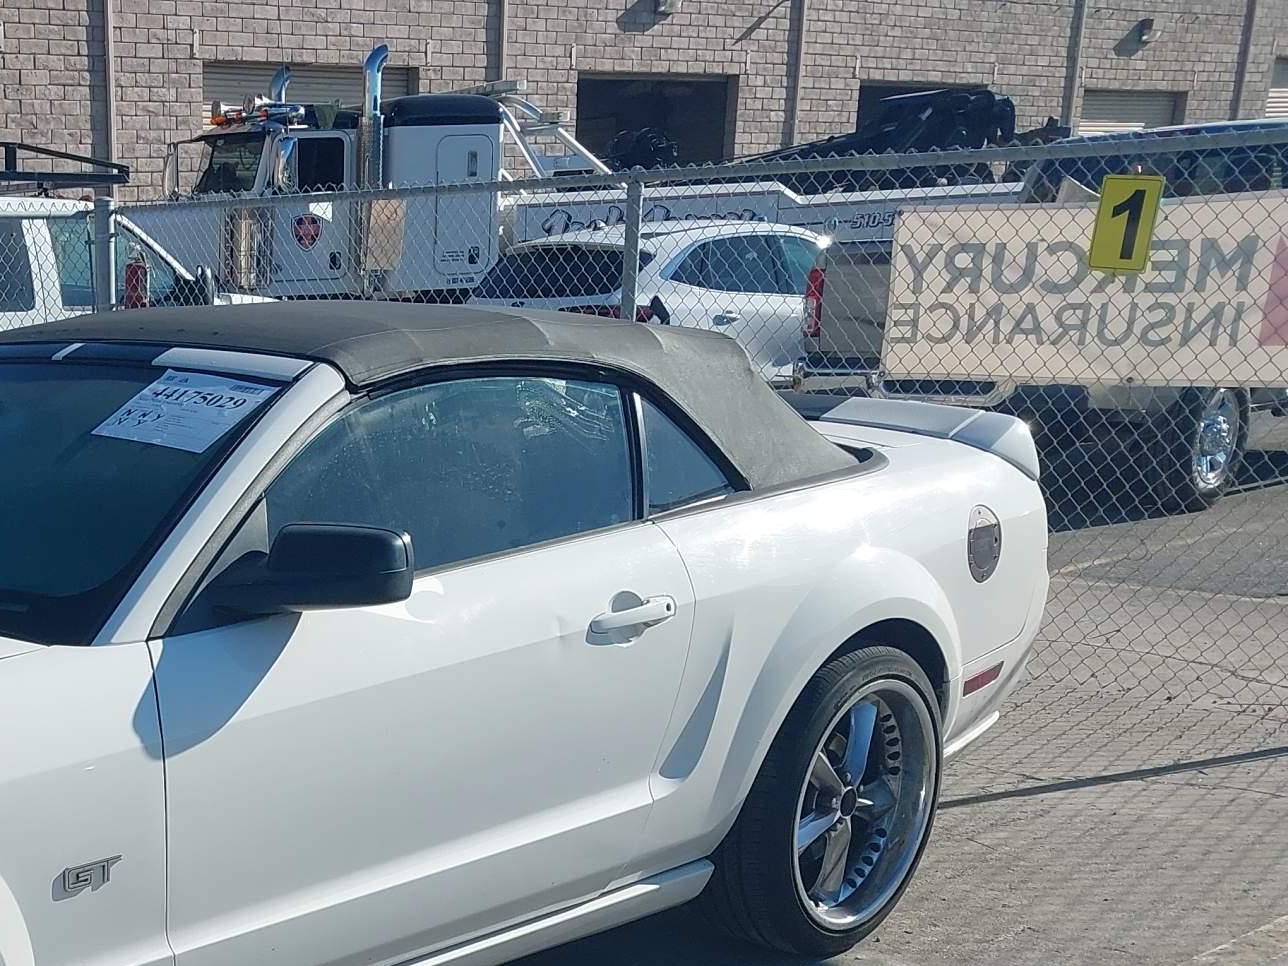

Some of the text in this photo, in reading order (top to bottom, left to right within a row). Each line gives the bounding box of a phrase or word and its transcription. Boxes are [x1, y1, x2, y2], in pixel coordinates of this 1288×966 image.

[1111, 188, 1147, 261] 1
[152, 386, 248, 411] 44175029
[52, 854, 123, 902] GT
